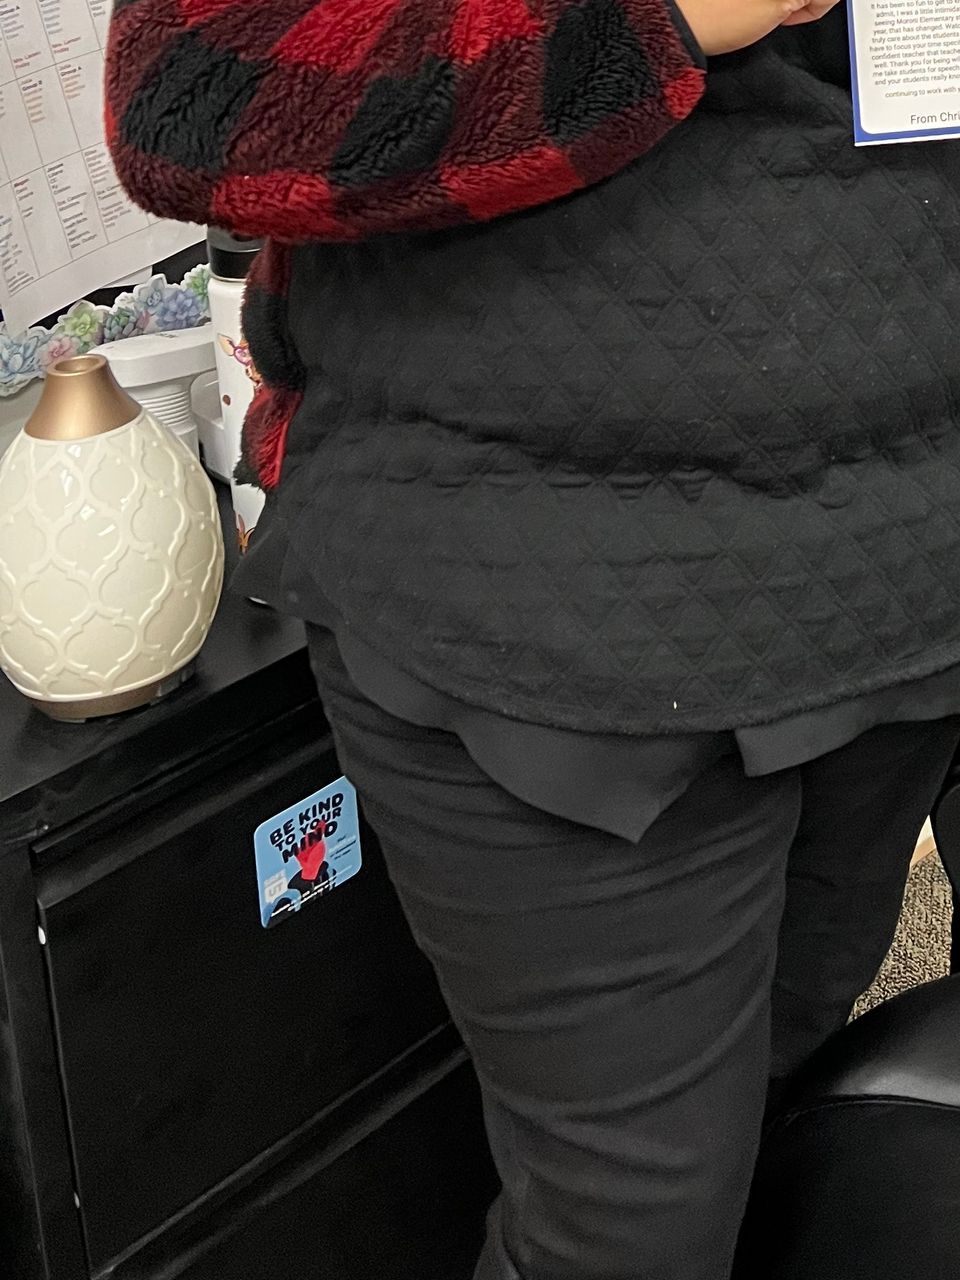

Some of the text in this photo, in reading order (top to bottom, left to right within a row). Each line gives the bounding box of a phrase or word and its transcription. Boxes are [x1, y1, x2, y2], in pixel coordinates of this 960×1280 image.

[910, 114, 937, 125] From
[269, 792, 344, 845] BE KIND
[275, 807, 342, 852] TO YOUR
[281, 821, 338, 864] MIND
